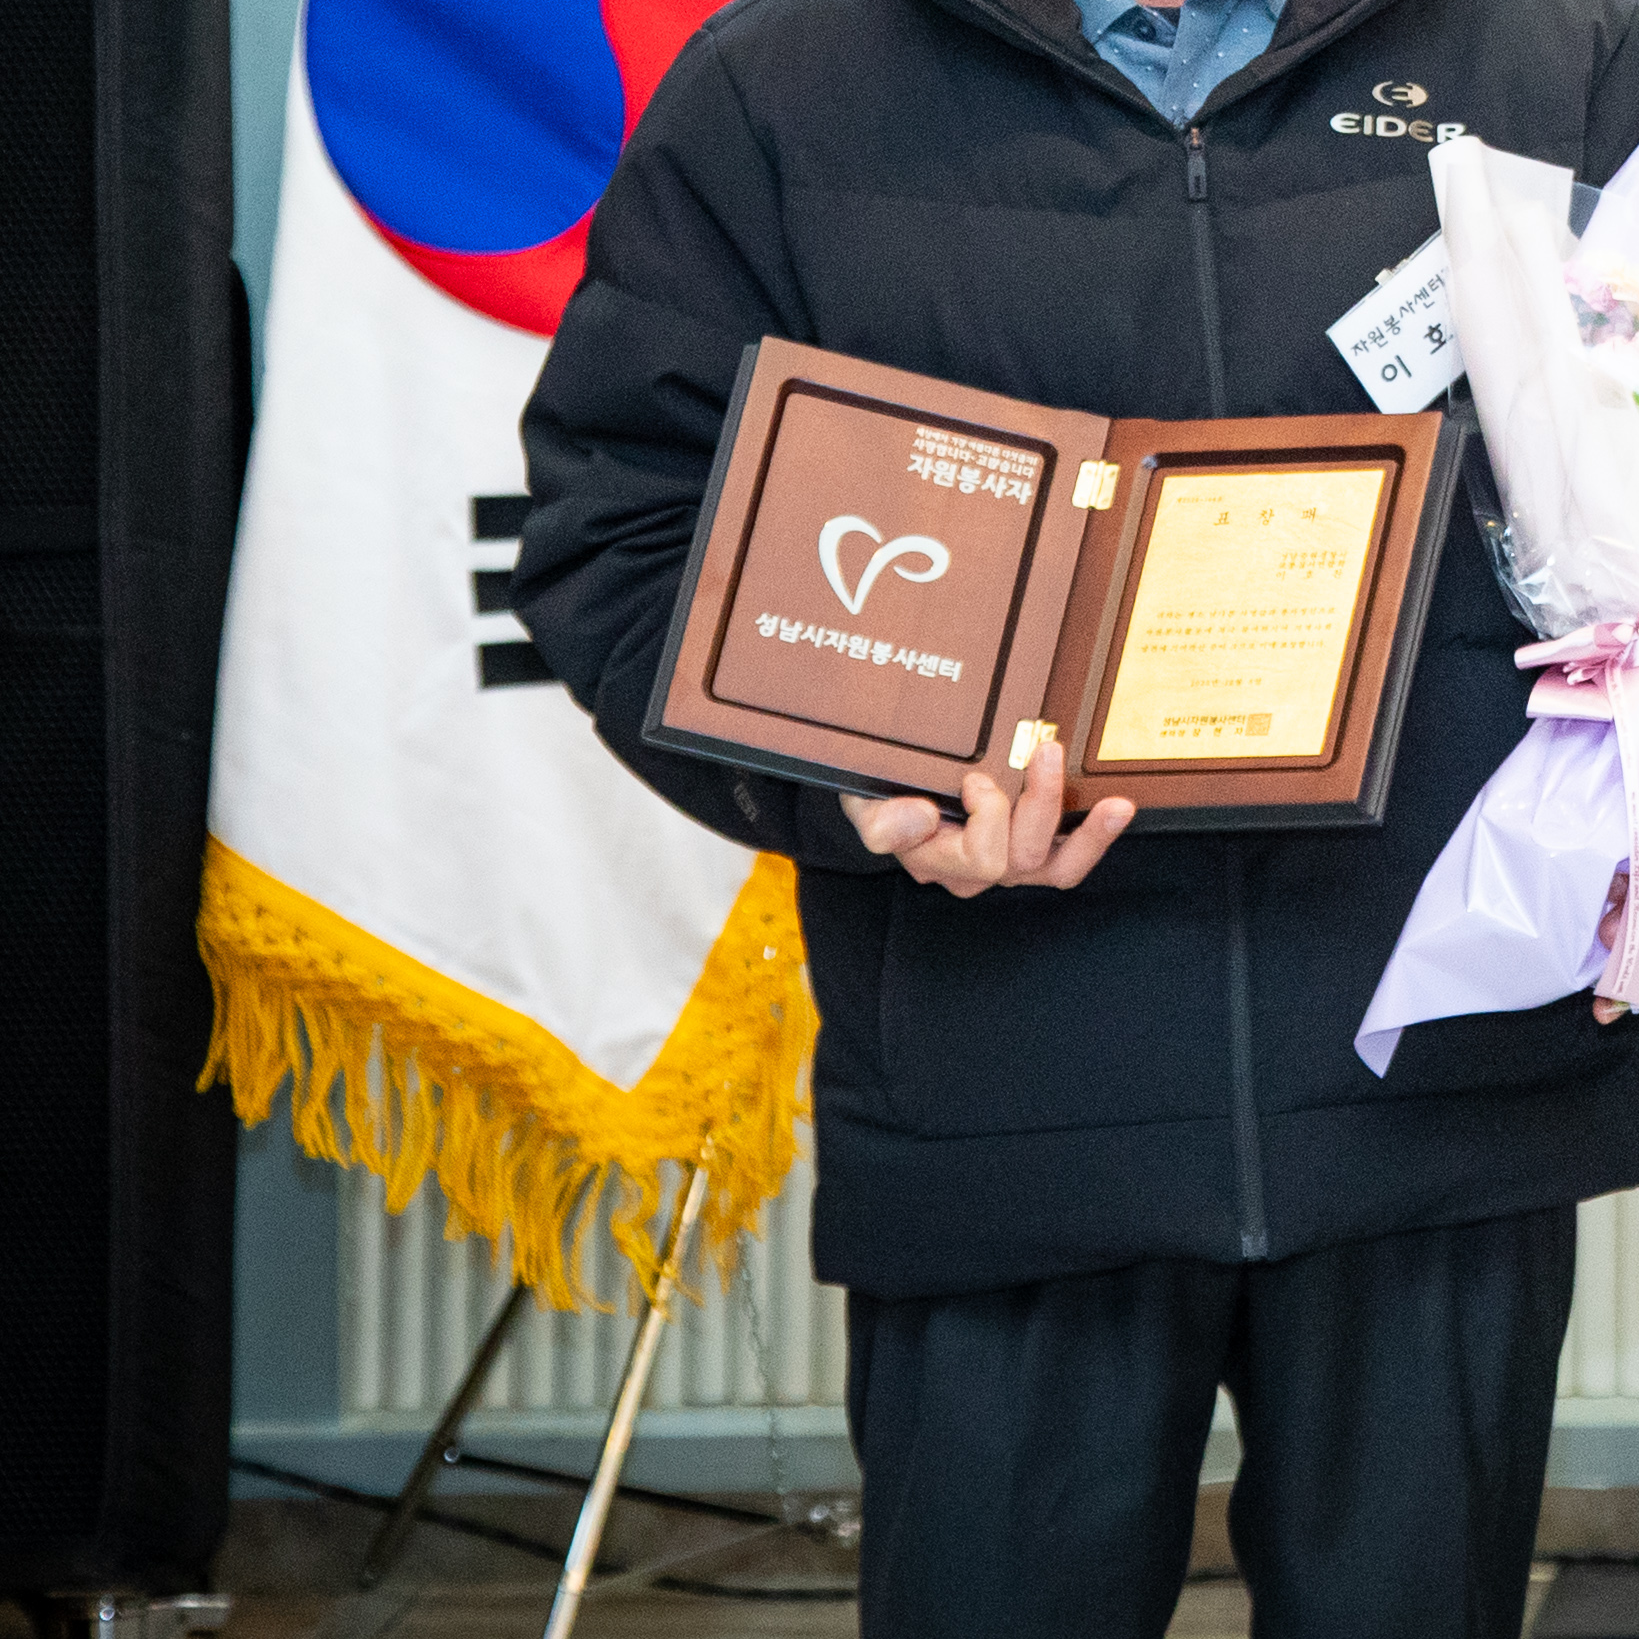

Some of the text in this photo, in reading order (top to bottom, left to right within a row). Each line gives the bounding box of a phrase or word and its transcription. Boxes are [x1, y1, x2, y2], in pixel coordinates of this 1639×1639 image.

[1329, 112, 1467, 144] EIDER
[1350, 267, 1450, 358] 자원봉사센터
[907, 453, 1033, 505] 자원봉사자
[755, 612, 963, 683] 성남시자원봉사센터
